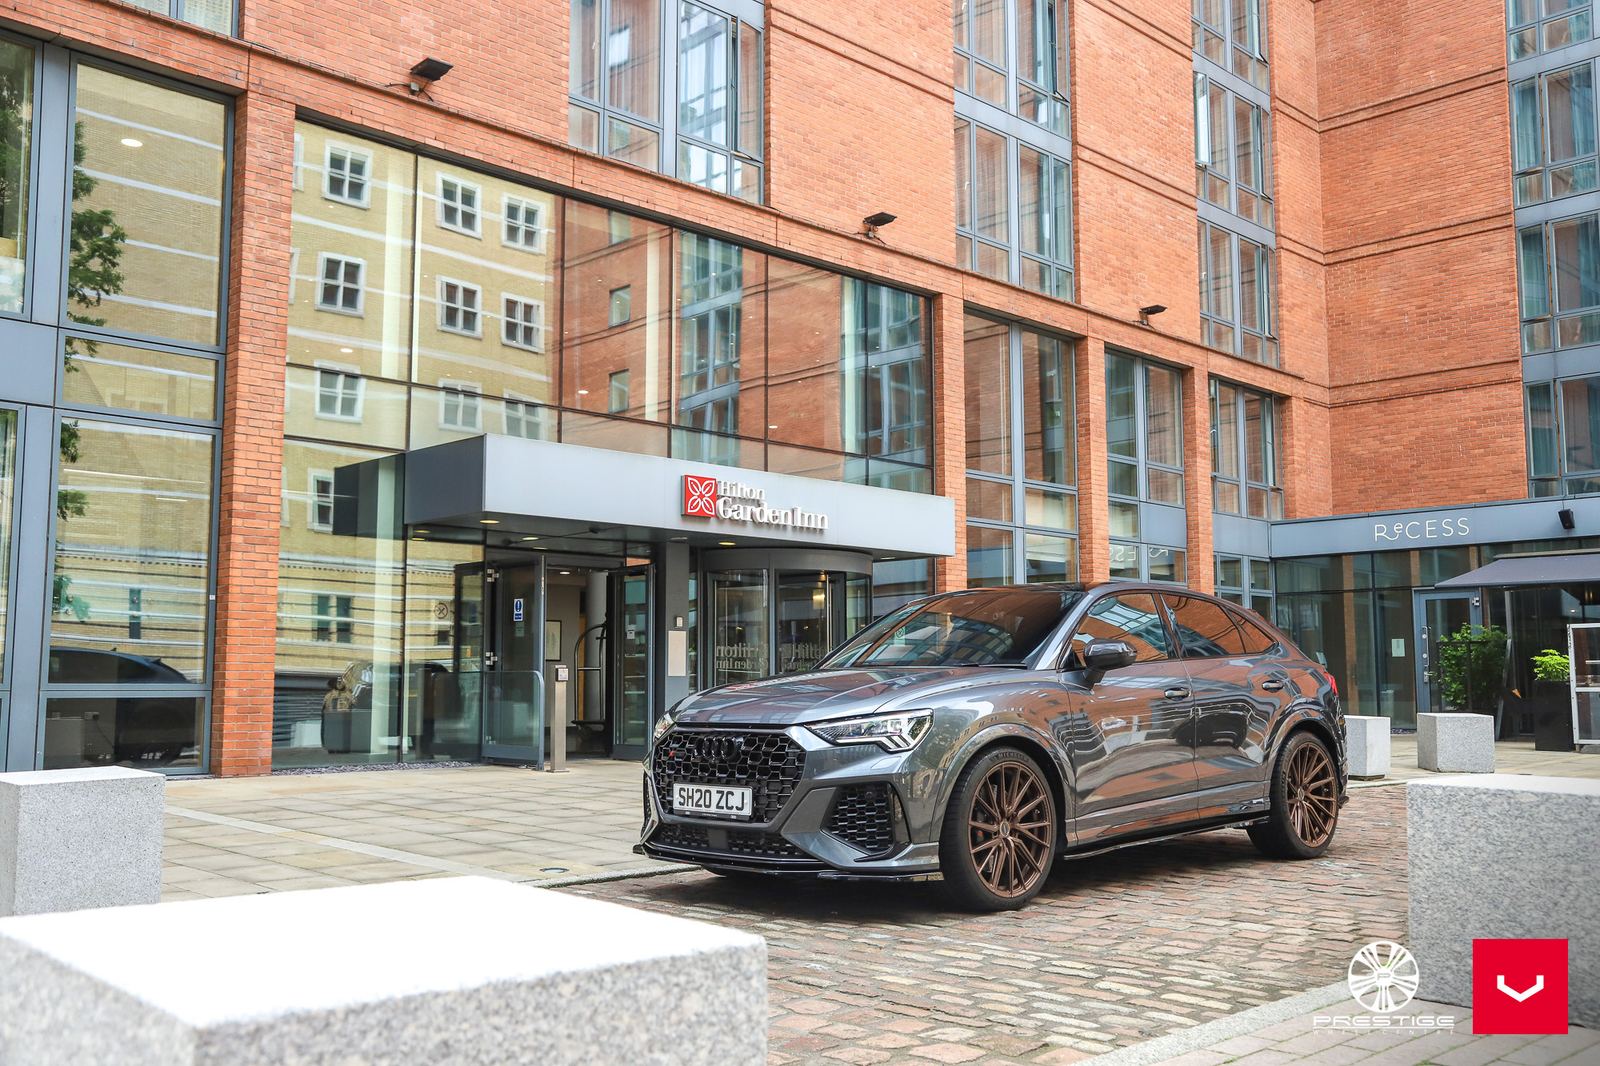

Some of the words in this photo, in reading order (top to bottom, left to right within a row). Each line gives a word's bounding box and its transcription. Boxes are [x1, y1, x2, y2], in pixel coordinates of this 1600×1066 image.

[718, 480, 765, 499] Hilton
[680, 788, 711, 808] SH20
[716, 790, 745, 811] ZCJ
